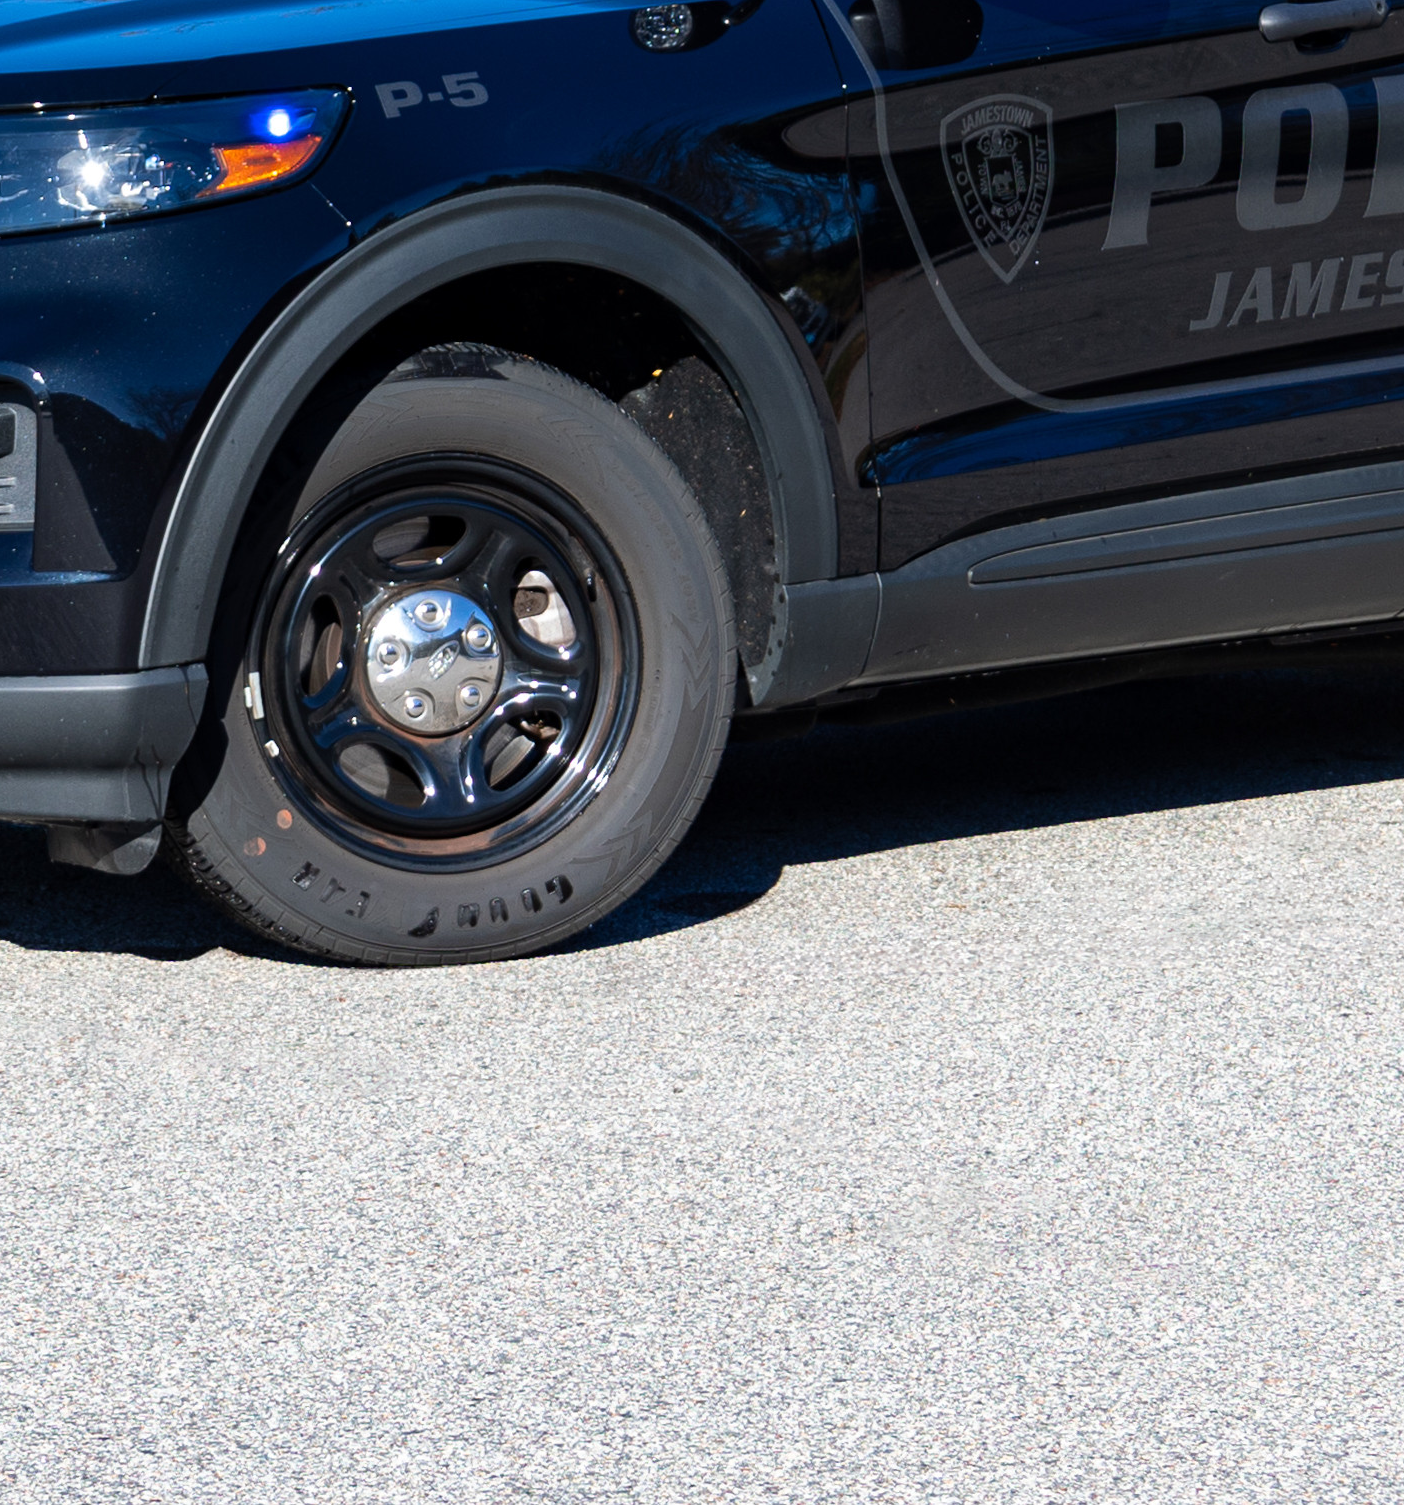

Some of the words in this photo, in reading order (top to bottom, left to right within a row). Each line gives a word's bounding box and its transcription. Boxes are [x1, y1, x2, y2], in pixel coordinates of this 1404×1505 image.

[375, 71, 489, 119] P-5
[961, 105, 1035, 135] JAMESTOWN
[951, 152, 996, 247] POLICE
[1009, 134, 1048, 255] DEPARTMENT
